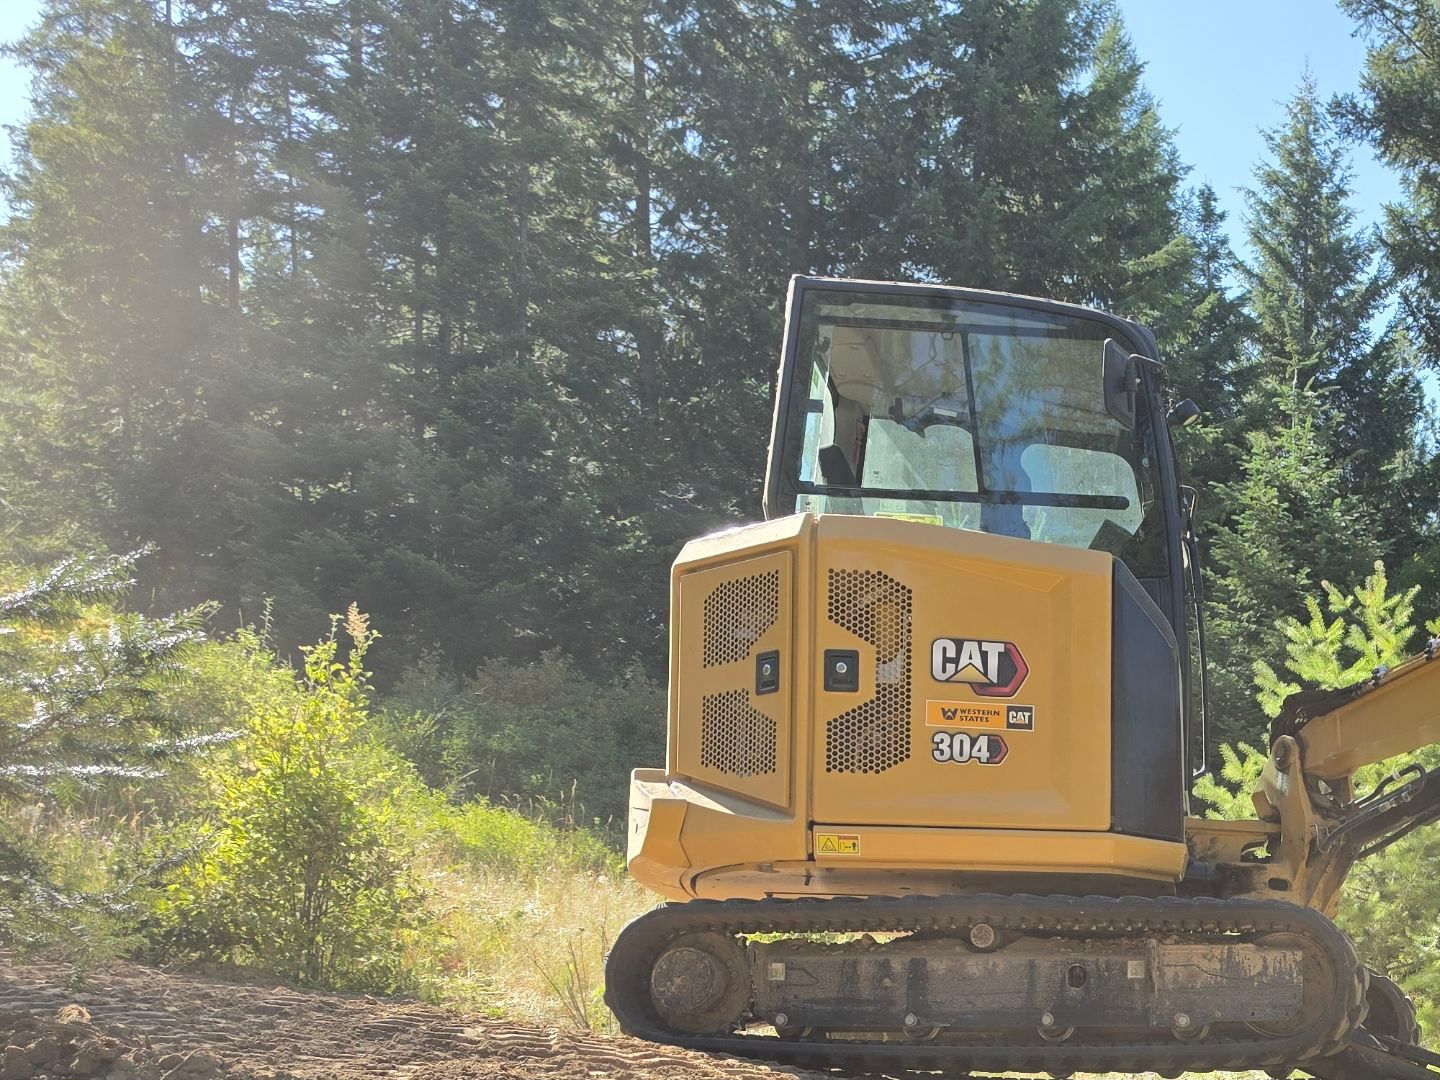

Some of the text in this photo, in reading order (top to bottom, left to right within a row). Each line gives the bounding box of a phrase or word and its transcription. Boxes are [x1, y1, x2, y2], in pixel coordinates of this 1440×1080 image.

[932, 638, 1005, 684] CAT
[959, 707, 1001, 717] WESTERN
[959, 715, 989, 723] STATES
[1008, 711, 1032, 725] CAT
[932, 732, 990, 763] 304
